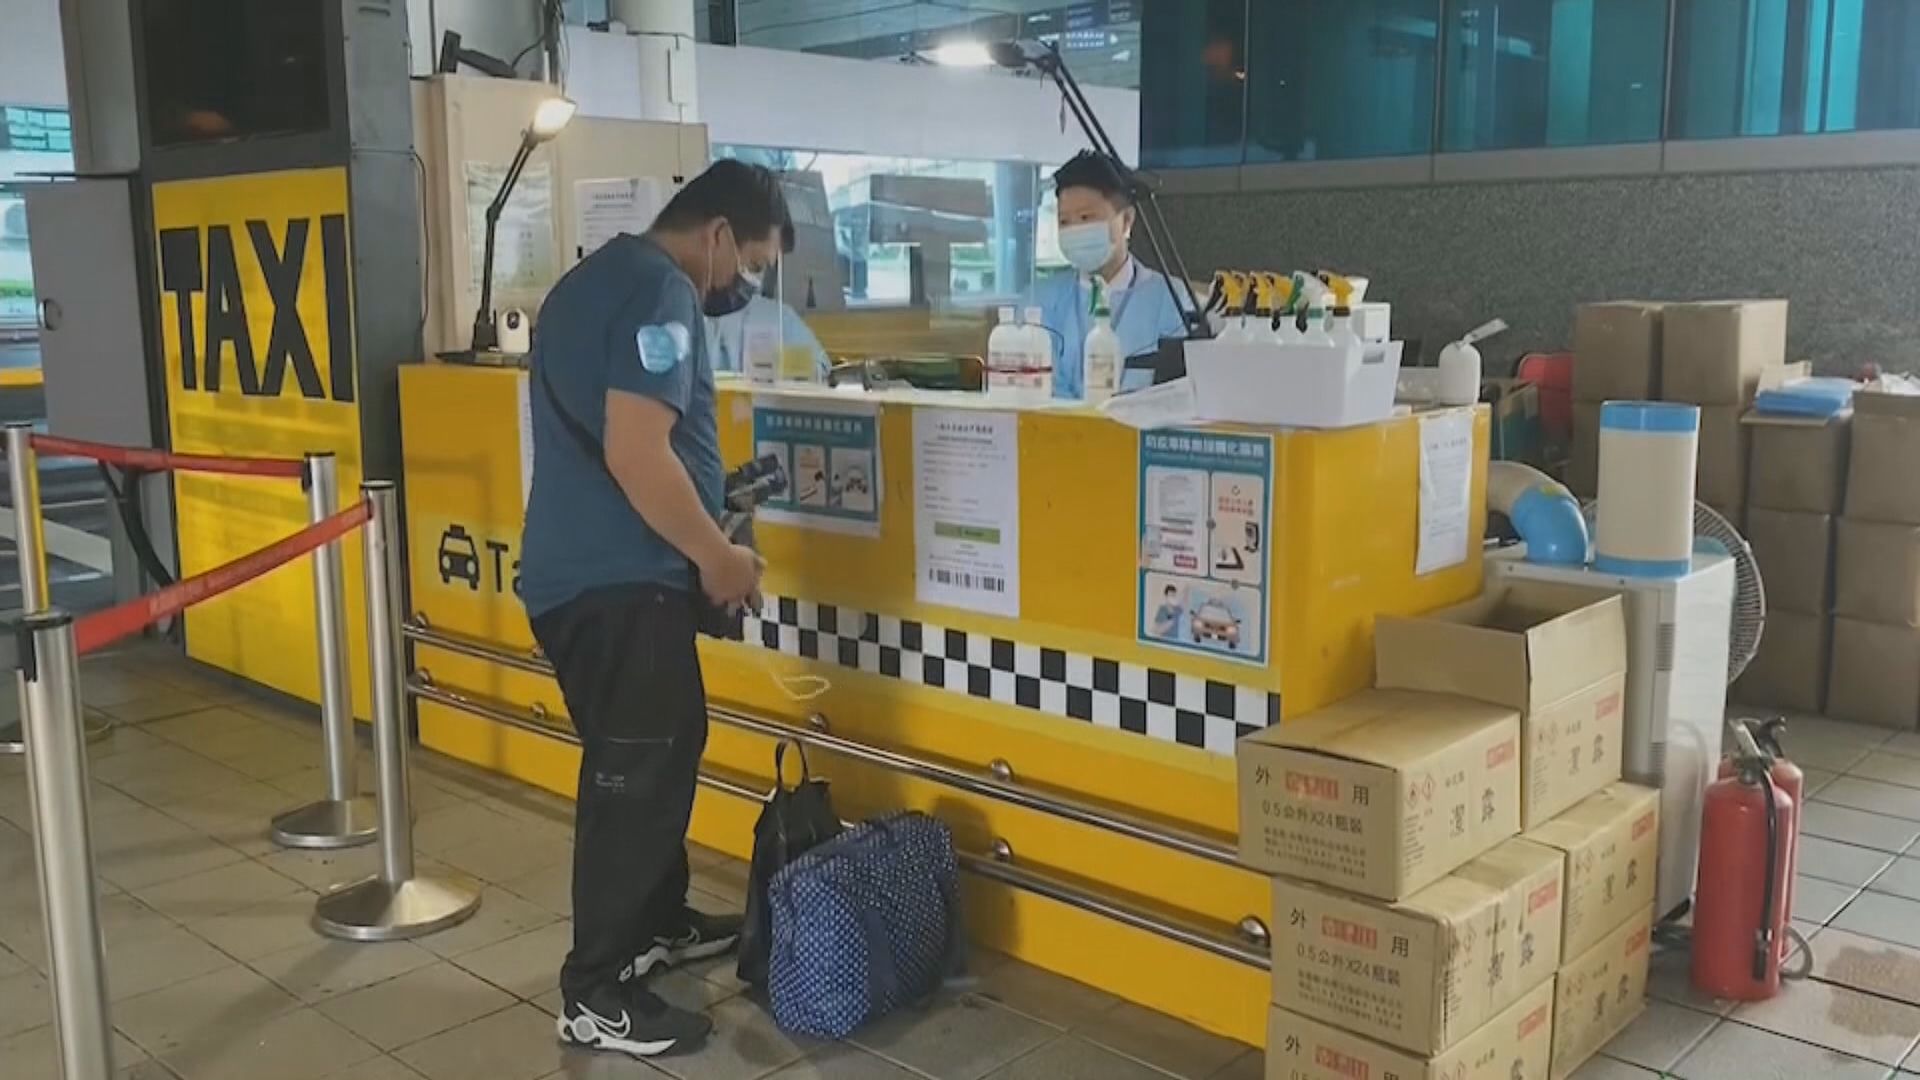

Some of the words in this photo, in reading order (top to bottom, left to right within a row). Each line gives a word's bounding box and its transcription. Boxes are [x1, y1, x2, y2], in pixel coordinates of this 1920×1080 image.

[159, 213, 355, 403] TAXI
[1255, 764, 1272, 787] 外
[1352, 784, 1370, 808] 用
[1290, 907, 1306, 929] 外
[1391, 935, 1410, 958] 用
[1284, 1034, 1302, 1056] 外
